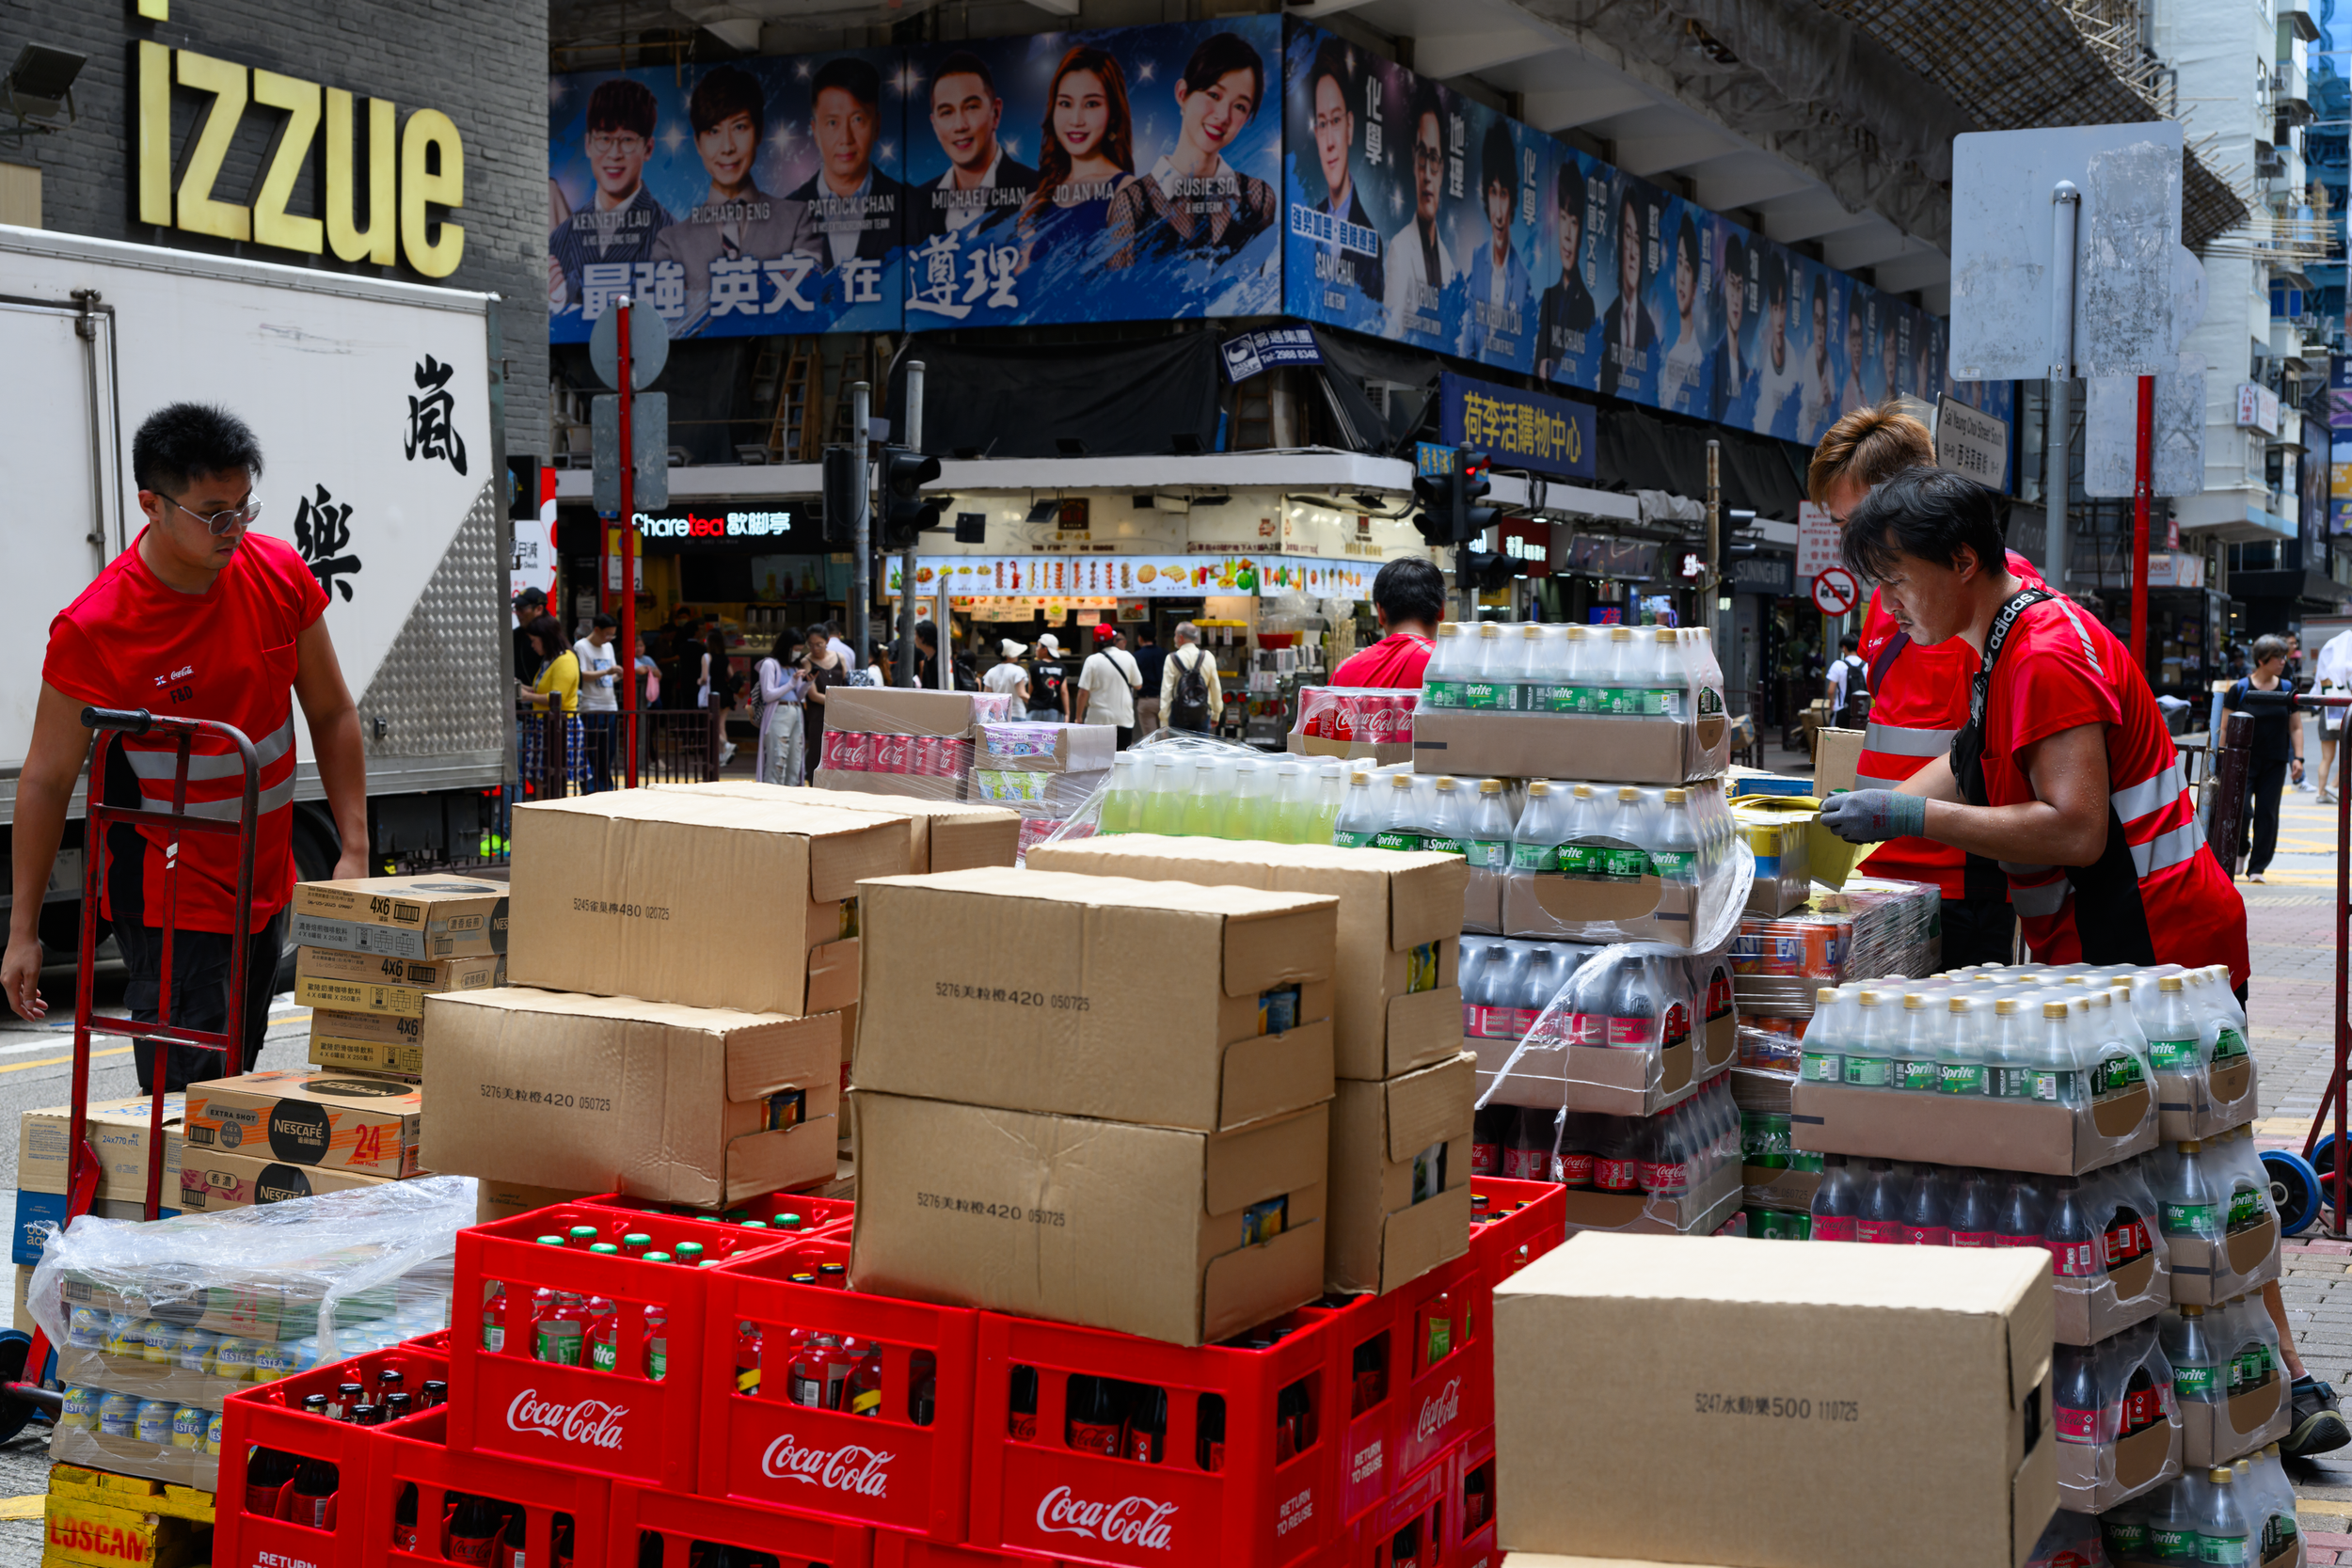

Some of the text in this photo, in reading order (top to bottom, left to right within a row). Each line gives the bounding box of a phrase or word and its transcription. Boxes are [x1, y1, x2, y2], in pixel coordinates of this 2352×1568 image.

[1365, 75, 1382, 166] 化學
[138, 0, 465, 277] izzue
[931, 187, 1026, 210] MICHAEL CHAN
[1052, 182, 1115, 203] JO AN MA
[1173, 177, 1235, 198] SUSIE SO
[691, 201, 771, 224] RICHARD ENG
[807, 194, 896, 217] PATRICK CHAN
[1206, 202, 1223, 213] TEAM
[572, 209, 651, 231] KENNETH LAU
[581, 230, 1020, 321] 最強 英文 在 遵理
[404, 354, 469, 477] 嵐
[1464, 389, 1581, 464] 荷李活購物中心
[1944, 407, 1953, 427] Sai
[1954, 410, 1967, 436] Yeung
[1967, 416, 1978, 436] Choi
[1978, 420, 1992, 443] Street
[631, 513, 724, 537] Sharetea
[293, 483, 363, 604] 樂
[1736, 559, 1772, 583] SUNING
[1990, 591, 2034, 651] adidas
[170, 664, 195, 681] Coca-Cola
[169, 686, 193, 705] F&D
[1466, 683, 1493, 697] Sprite
[1375, 832, 1403, 847] Sprite
[1428, 838, 1461, 852] Sprite
[1651, 850, 1681, 865] Sprite
[370, 896, 390, 916] 4x6
[645, 907, 670, 921] 020725
[298, 922, 348, 936] 濃香焙煎咖啡飲料
[450, 917, 480, 930] 濃香焙煎
[381, 958, 403, 977] 4x6
[308, 983, 361, 995] 歐陸奶滑咖啡飲料
[935, 982, 1090, 1011] 5276美粒橙420 050725
[397, 1017, 419, 1037] 4x6
[321, 1041, 373, 1055] 歐陸奶滑咖啡飲料
[1941, 1066, 1976, 1081] Sprite
[480, 1084, 612, 1112] 5276美粒橙420 050725
[210, 1109, 256, 1122] EXTRA SHOT
[103, 1134, 139, 1147] 24x770 mL
[354, 1123, 381, 1160] 24
[212, 1173, 231, 1188] 香濃
[1781, 1189, 1808, 1200] 060725
[917, 1192, 1066, 1227] 5276美粒橙420 050725
[232, 1290, 259, 1324] 24
[219, 1349, 253, 1363] NESTEA
[2173, 1368, 2207, 1383] Sprite
[1417, 1375, 1462, 1442] Coca-Cola
[1694, 1393, 1859, 1421] 5247水動樂500 110725
[506, 1387, 630, 1450] Coca-Cola
[1353, 1439, 1382, 1469] RETURN
[762, 1433, 896, 1498] Coca-Cola
[1351, 1455, 1383, 1485] TO REUSE
[1279, 1487, 1311, 1519] RETURN
[1036, 1484, 1180, 1551] Coca-Cola
[1277, 1503, 1313, 1538] TO REUSE
[49, 1515, 150, 1562] LOSCAM
[2108, 1525, 2142, 1540] Sprite
[2151, 1530, 2182, 1545] Sprite
[258, 1549, 317, 1568] RETURN
